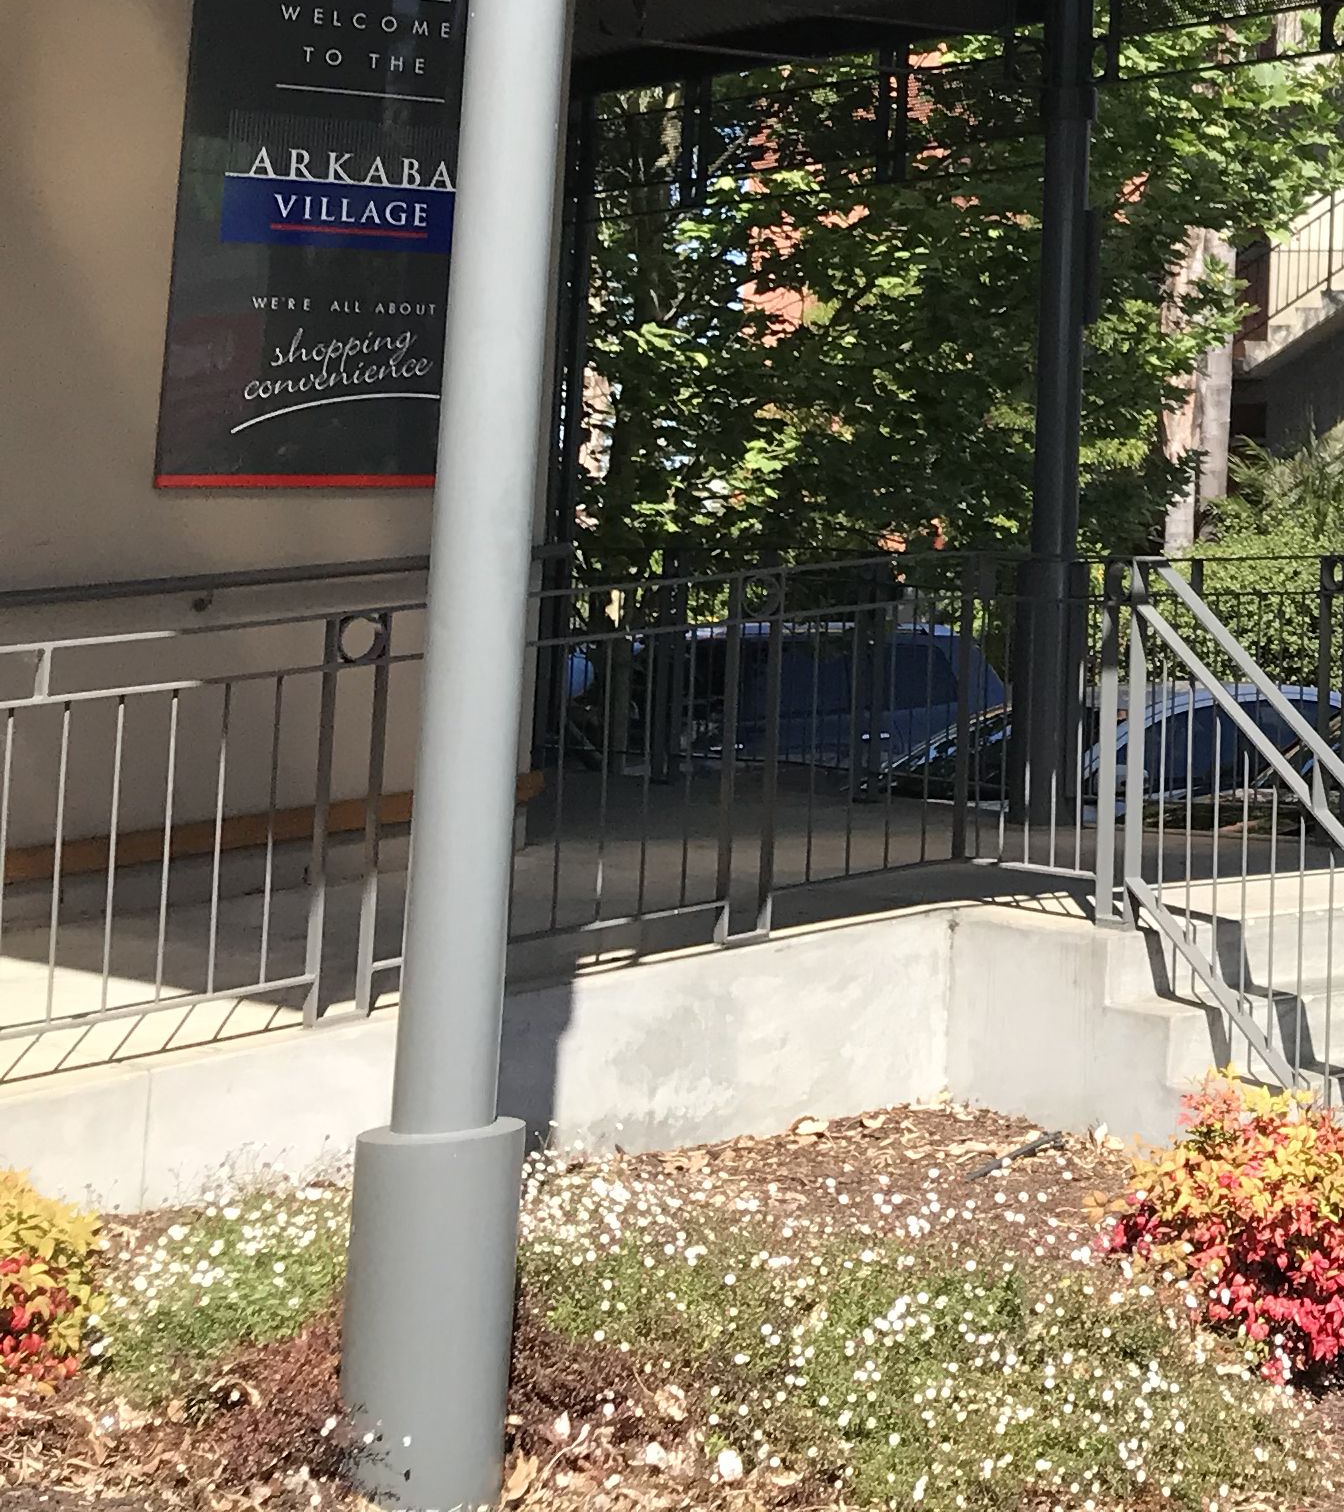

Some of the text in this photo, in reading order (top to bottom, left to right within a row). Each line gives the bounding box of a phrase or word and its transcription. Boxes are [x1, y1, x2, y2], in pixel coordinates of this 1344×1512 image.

[280, 3, 451, 38] WELCOME
[303, 45, 426, 75] TO THE
[248, 145, 455, 191] ARKABA
[273, 192, 428, 228] VILLAGE
[251, 295, 438, 316] WE'RE ALL ABOUT
[269, 327, 418, 374] shopping
[243, 356, 435, 401] convenience
